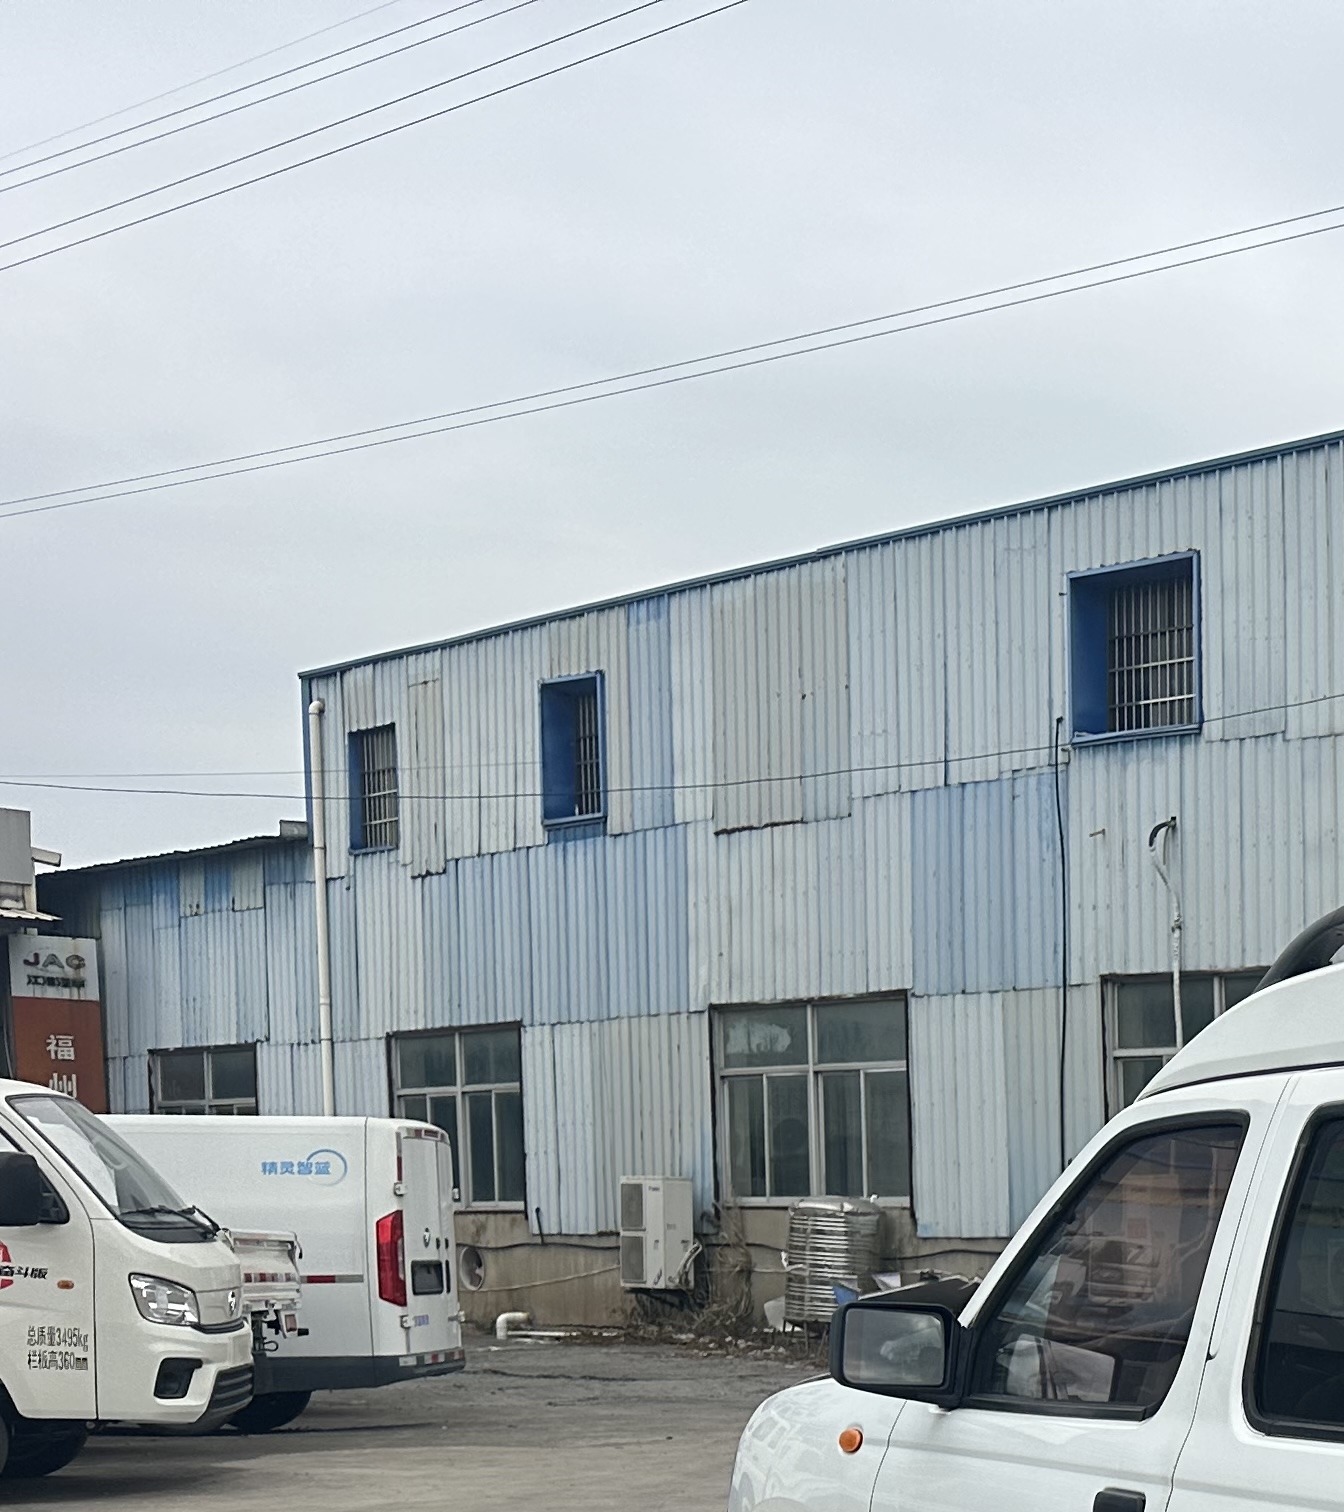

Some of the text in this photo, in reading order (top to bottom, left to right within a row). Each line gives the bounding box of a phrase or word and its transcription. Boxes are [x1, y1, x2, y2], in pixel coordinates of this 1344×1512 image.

[23, 952, 86, 970] JAC
[261, 1161, 331, 1175] 精灵智蓝
[27, 1325, 89, 1352] 总质量3495kg
